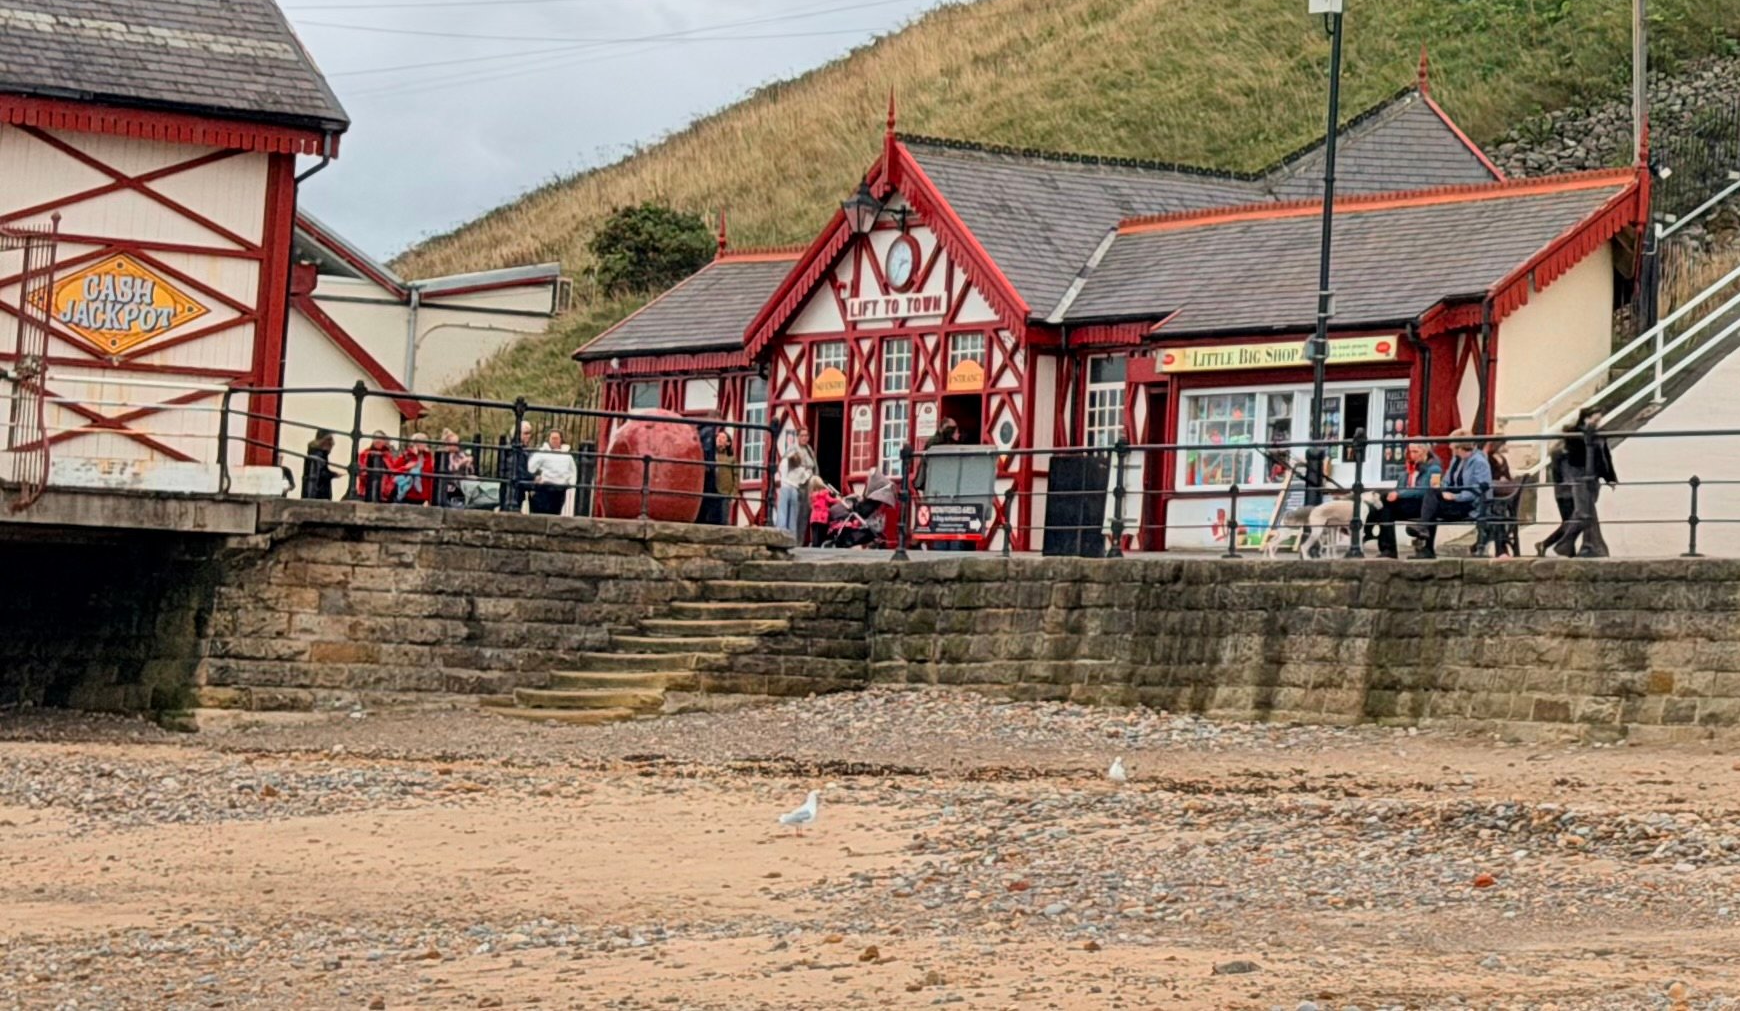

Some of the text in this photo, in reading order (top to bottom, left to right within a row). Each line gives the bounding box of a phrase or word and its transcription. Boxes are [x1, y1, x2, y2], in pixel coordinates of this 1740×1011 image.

[84, 274, 155, 305] CASH
[60, 300, 174, 332] JACKPOT
[850, 294, 942, 318] LIFT TO TOWN
[1193, 350, 1235, 367] LITTLE
[1239, 347, 1260, 364] BIG
[1265, 346, 1298, 363] SHOP
